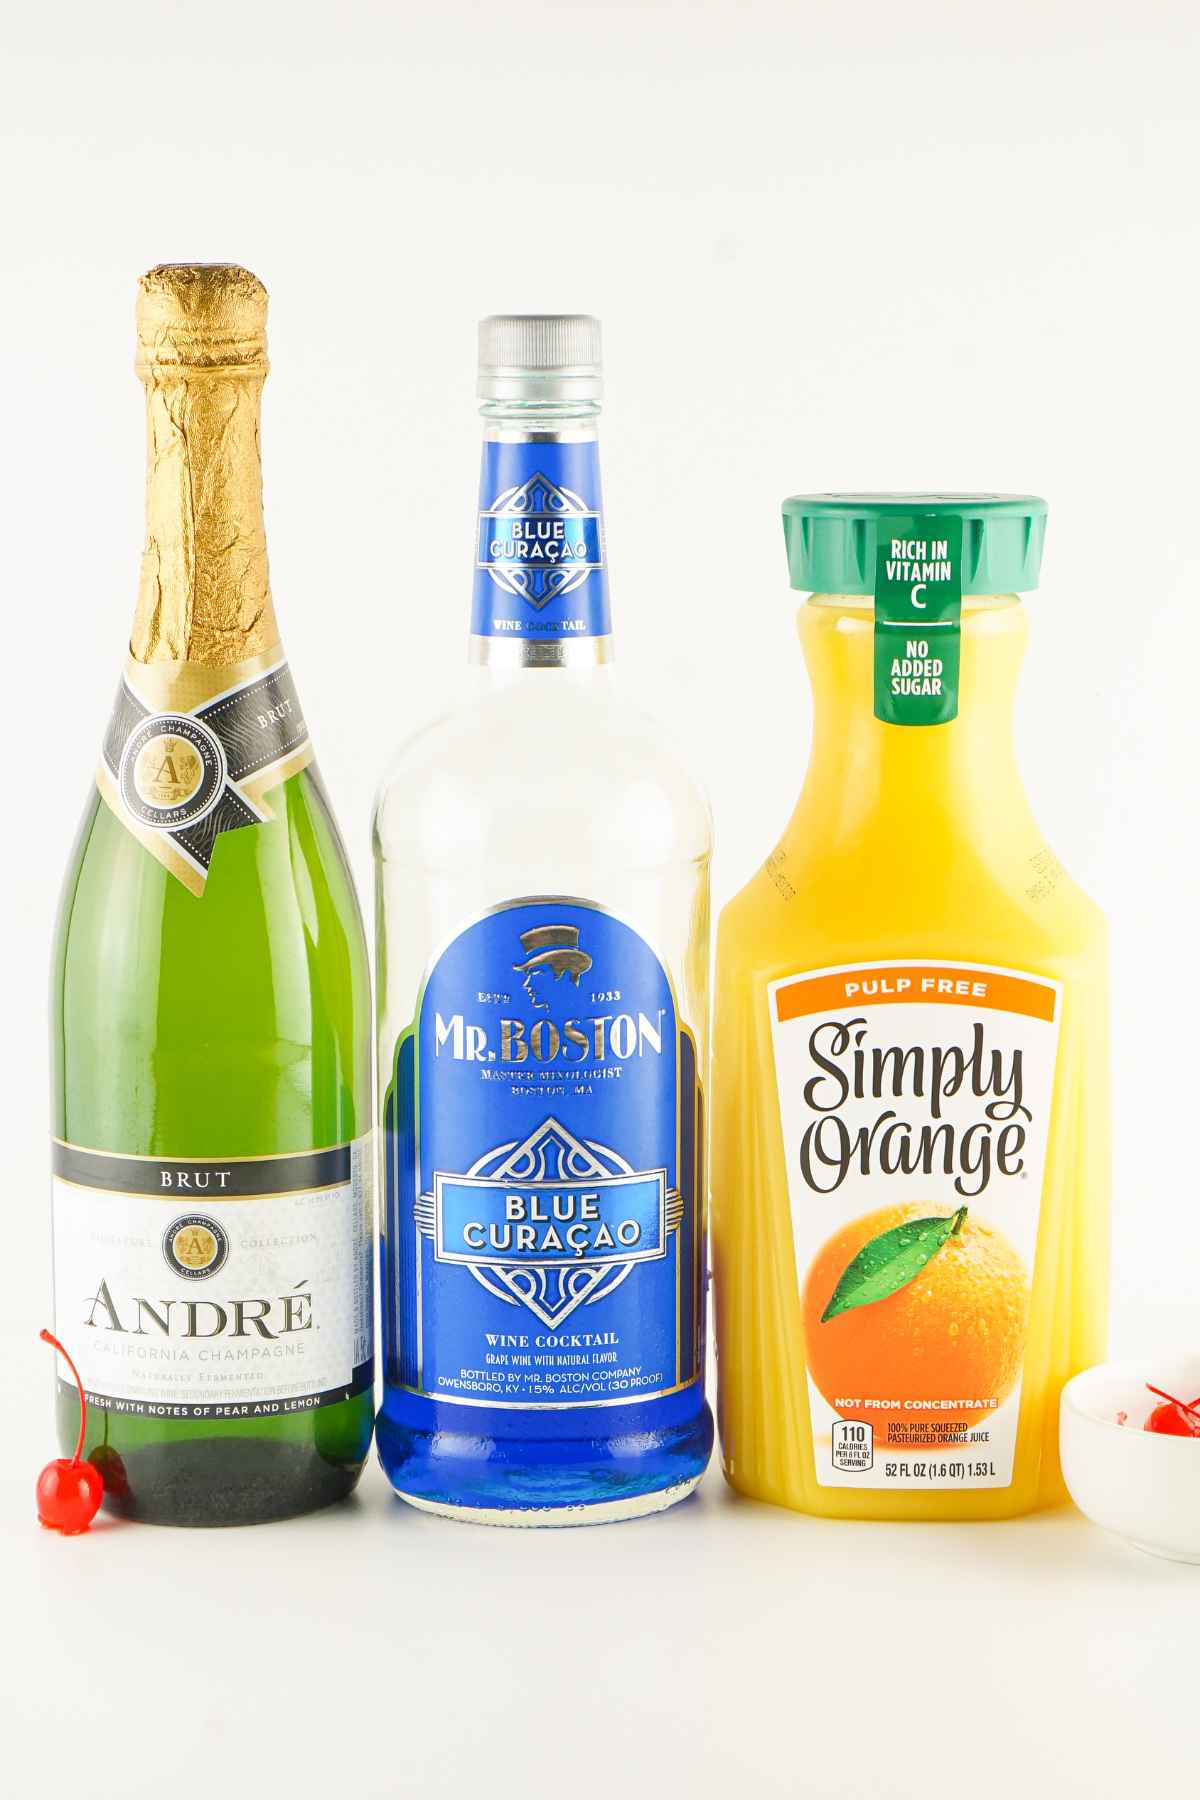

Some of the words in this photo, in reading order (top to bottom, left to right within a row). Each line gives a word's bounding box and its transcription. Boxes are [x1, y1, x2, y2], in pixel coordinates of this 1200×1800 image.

[511, 521, 564, 539] BLUE
[489, 540, 587, 563] CURAÇAO
[891, 539, 925, 560] RICH
[931, 540, 947, 560] IN
[885, 561, 951, 581] VITAMIN
[910, 583, 927, 609] C
[493, 620, 522, 632] WINE
[906, 641, 928, 658] NO
[890, 659, 943, 677] ADDED
[891, 678, 941, 696] SUGAR
[257, 700, 292, 729] BRUT
[591, 990, 621, 1002] 1933
[844, 977, 911, 997] PULP
[921, 977, 987, 997] FREE
[500, 1011, 663, 1064] BOSTON
[803, 1018, 1033, 1121] Simply
[799, 1110, 1026, 1197] Orange
[160, 1171, 231, 1188] BRUT
[506, 1193, 600, 1222] BLUE
[463, 1219, 641, 1257] CURAÇAO
[83, 1278, 314, 1340] ANDRÉ
[485, 1333, 529, 1348] WINE
[535, 1332, 619, 1348] COCKTAIL
[93, 1339, 190, 1362] CALIFORNIA
[198, 1342, 306, 1362] CHAMPAGNE
[557, 1353, 590, 1366] NATURAL
[460, 1368, 505, 1382] BOTTLED
[508, 1373, 521, 1382] BY
[545, 1373, 589, 1383] BOSTON
[592, 1366, 642, 1380] COMPANY
[438, 1376, 503, 1393] OWENSBORO,
[506, 1383, 519, 1393] KY
[529, 1385, 555, 1394] 15%
[560, 1382, 606, 1393] ALC/VOL
[608, 1379, 628, 1391] (30
[84, 1393, 112, 1408] FRESH
[116, 1401, 144, 1413] WITH
[148, 1405, 189, 1416] NOTES
[193, 1406, 210, 1416] OF
[216, 1406, 249, 1416] PEAR
[254, 1402, 279, 1414] AND
[284, 1397, 321, 1411] LEMON
[835, 1399, 861, 1409] NOT
[865, 1399, 901, 1409] FROM
[903, 1399, 998, 1410] CONCENTRATE
[842, 1426, 865, 1442] 110
[909, 1423, 929, 1433] PURE
[930, 1422, 968, 1433] SQUEEZED
[887, 1433, 936, 1443] PASTEURIZED
[937, 1433, 968, 1443] ORANGE
[970, 1431, 990, 1442] JUICE
[839, 1458, 867, 1467] SERVING
[885, 1463, 898, 1477] 52
[899, 1463, 911, 1477] FL
[913, 1463, 926, 1477] OZ
[929, 1463, 946, 1480] (1.6
[949, 1463, 965, 1479] QT)
[967, 1463, 988, 1477] 1.53
[990, 1462, 996, 1476] L
